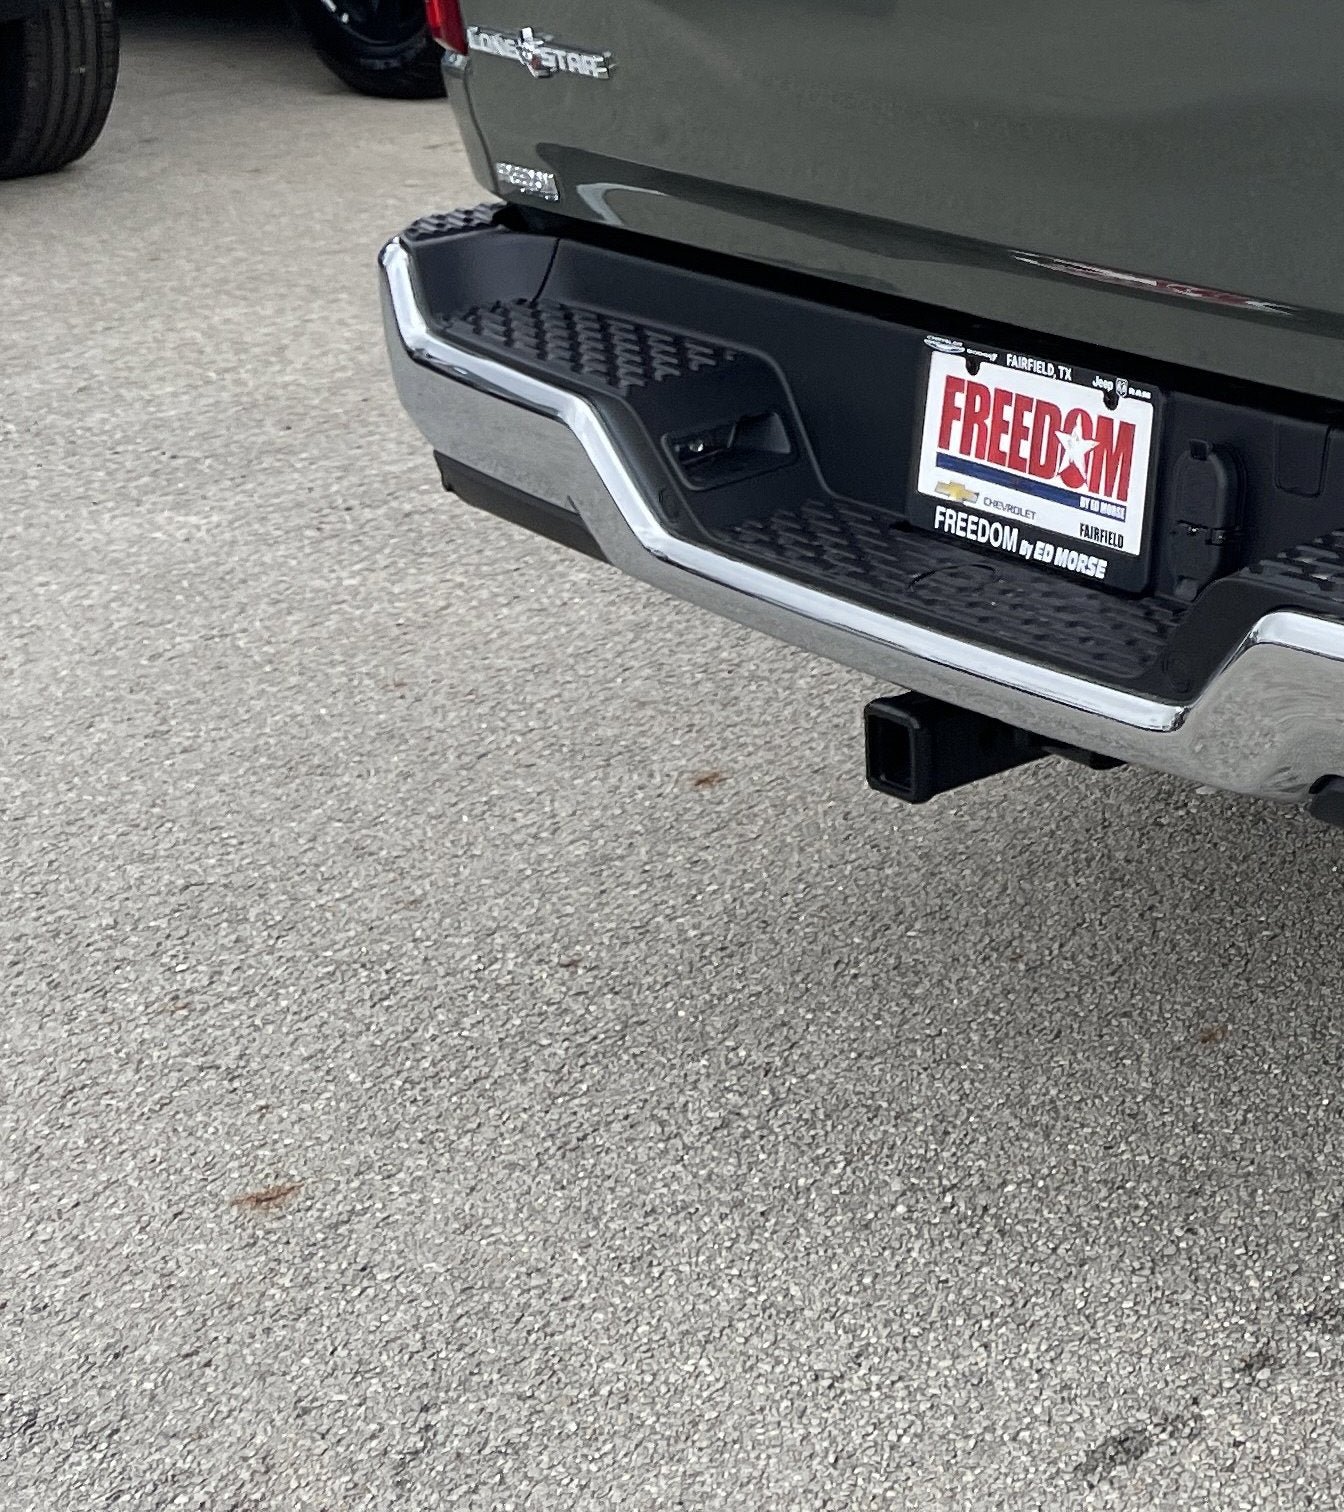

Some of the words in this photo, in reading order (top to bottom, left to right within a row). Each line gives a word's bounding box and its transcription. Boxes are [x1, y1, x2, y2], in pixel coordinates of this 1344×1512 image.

[1058, 366, 1072, 382] TX
[1092, 375, 1114, 392] Jeep
[938, 375, 1136, 502] FREEDOM
[983, 496, 1037, 520] CHEVROLET
[935, 506, 1018, 553] FREEDOM
[1033, 541, 1053, 564] ED
[1053, 547, 1108, 579] MORSE
[1080, 522, 1124, 549] FAIRFIELD
